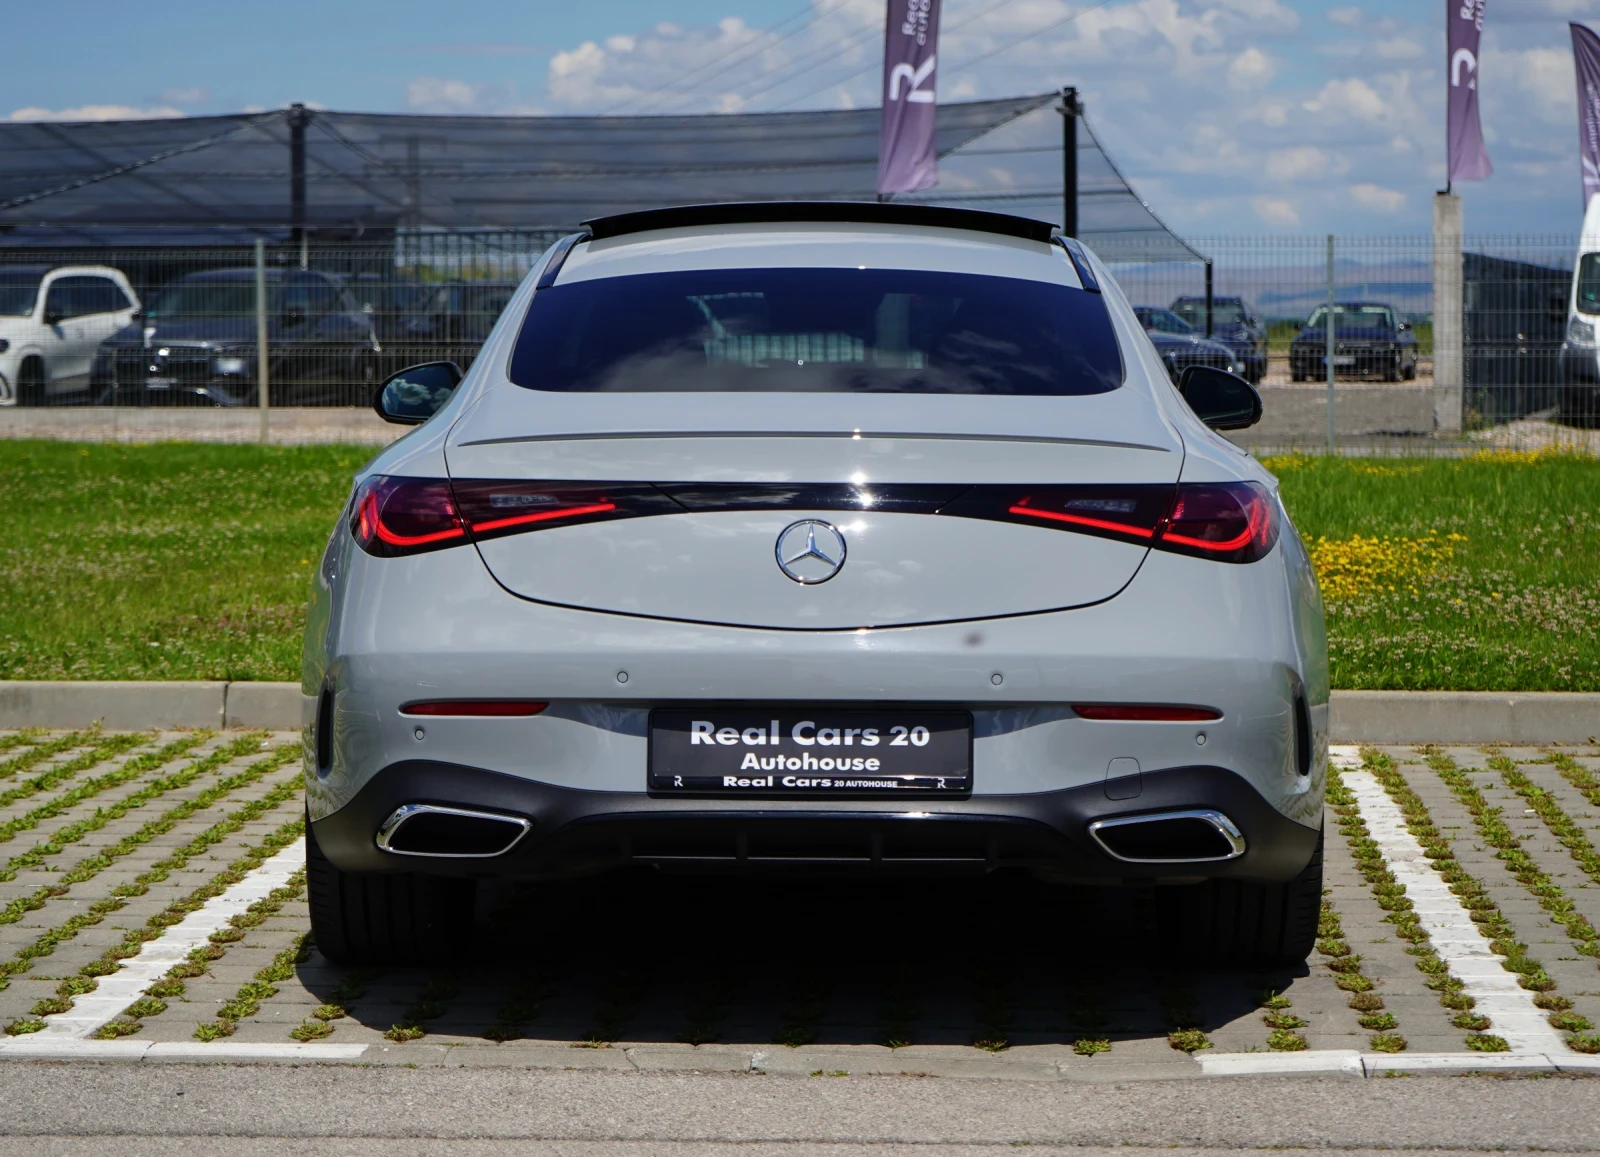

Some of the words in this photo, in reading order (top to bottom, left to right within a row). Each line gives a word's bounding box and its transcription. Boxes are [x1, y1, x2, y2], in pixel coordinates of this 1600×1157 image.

[691, 720, 780, 745] Real
[791, 721, 880, 747] Cars
[889, 725, 930, 747] 20
[740, 753, 881, 771] Autohouse
[723, 775, 774, 787] Real
[782, 776, 832, 787] Cars
[846, 780, 898, 788] AUTOHOUSE
